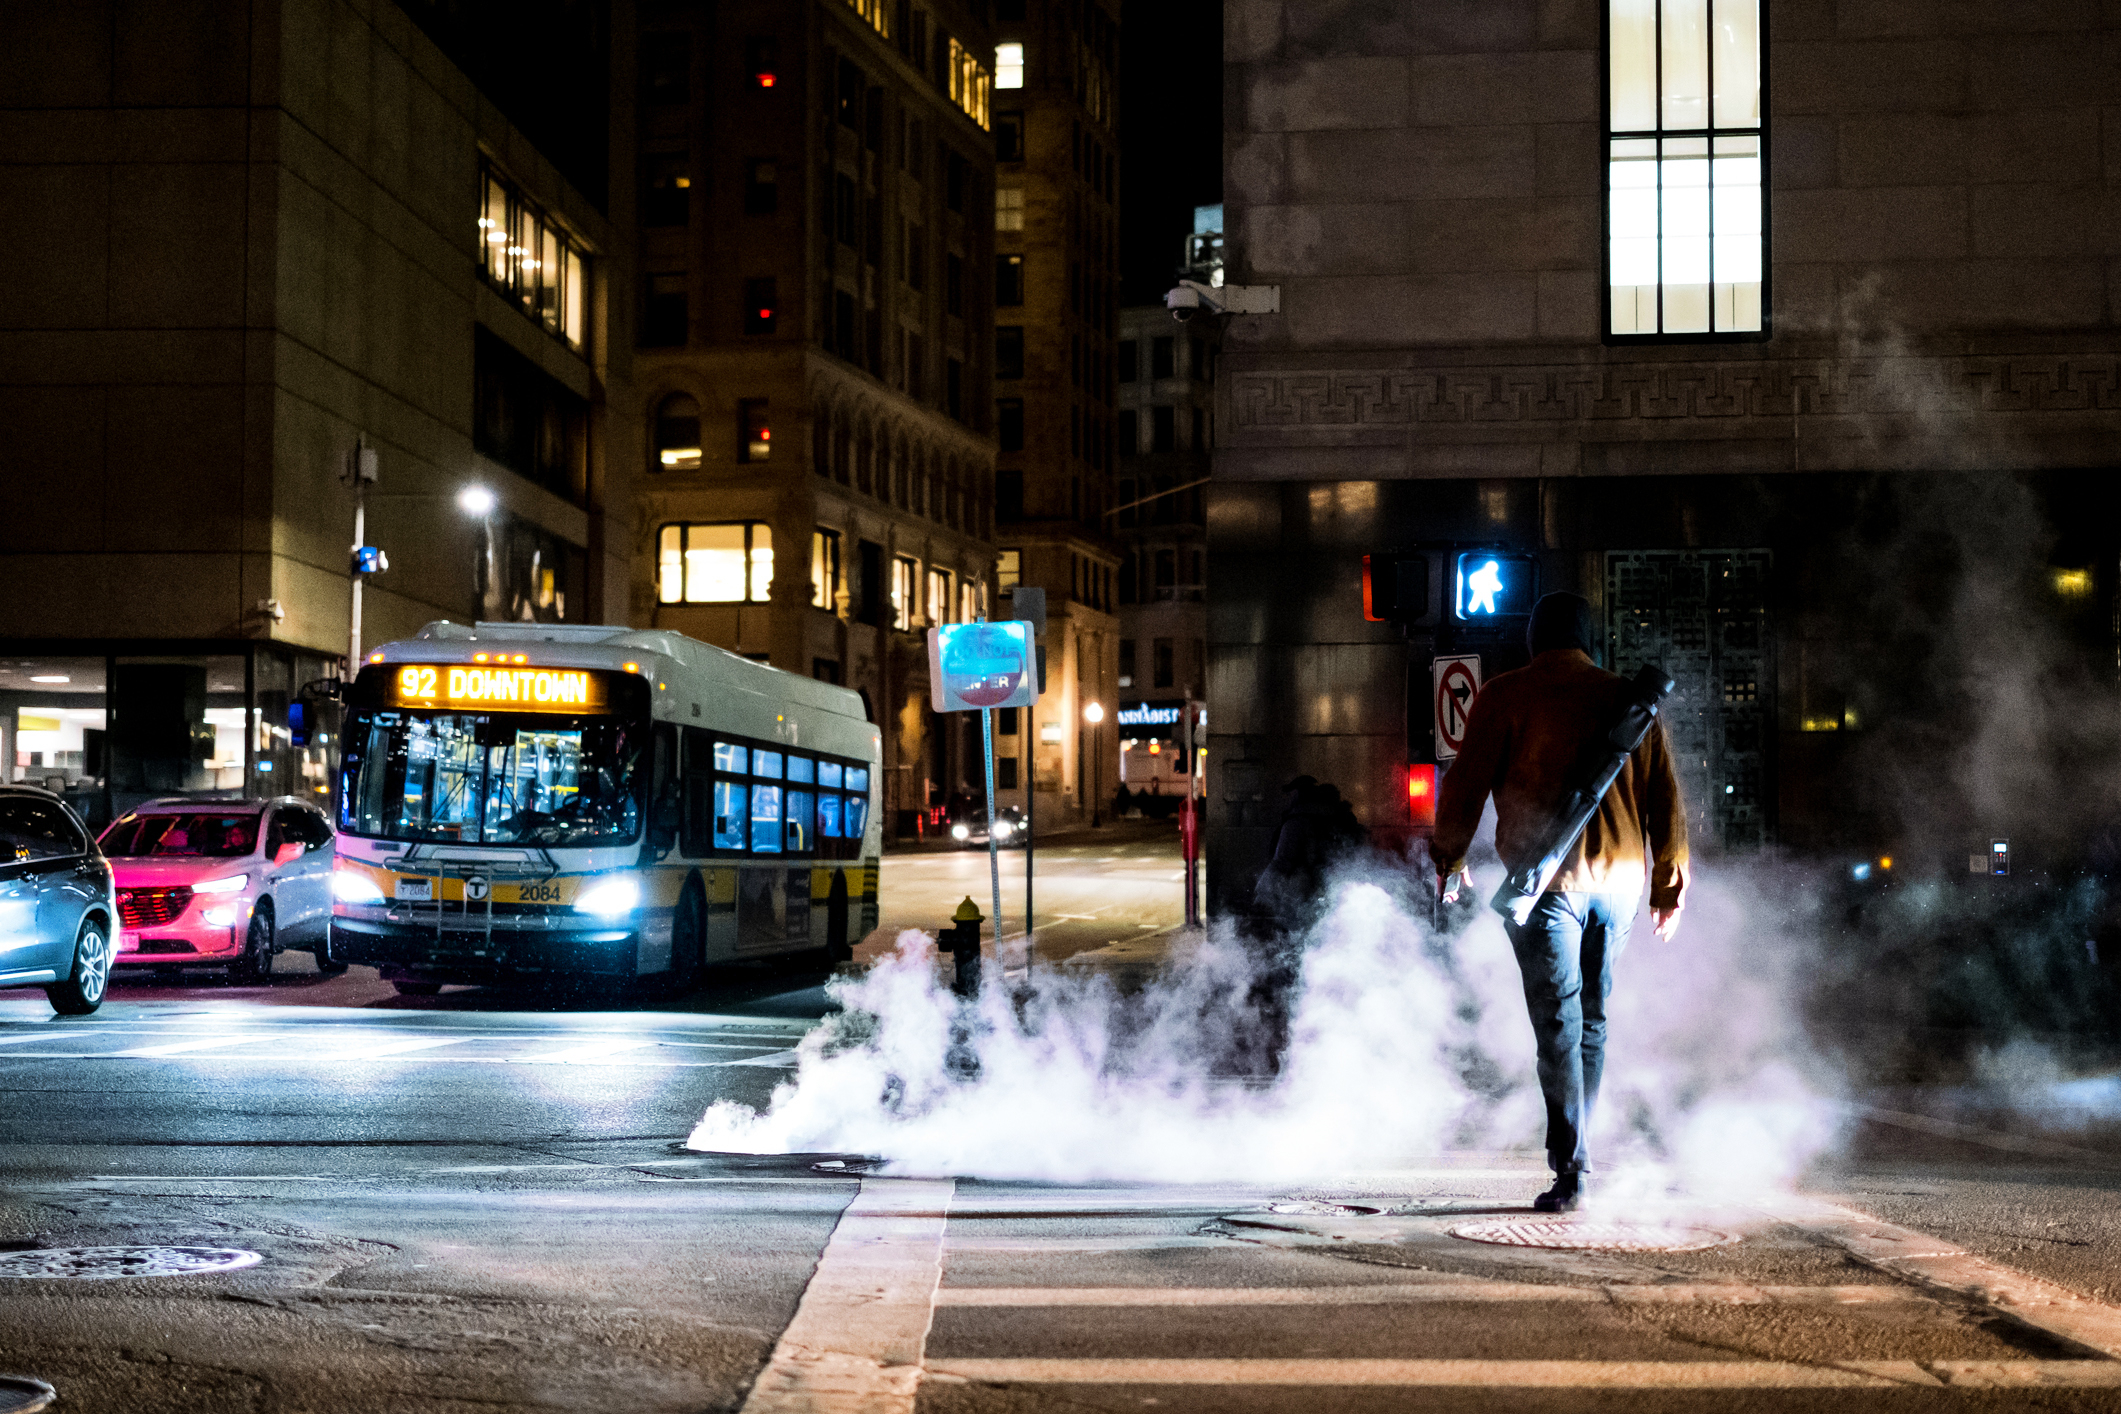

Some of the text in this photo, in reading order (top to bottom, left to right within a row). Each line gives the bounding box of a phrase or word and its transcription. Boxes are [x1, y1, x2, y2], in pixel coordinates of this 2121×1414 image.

[401, 668, 588, 703] 92 DOWNTOWN
[470, 882, 485, 897] T
[519, 885, 561, 902] 2084
